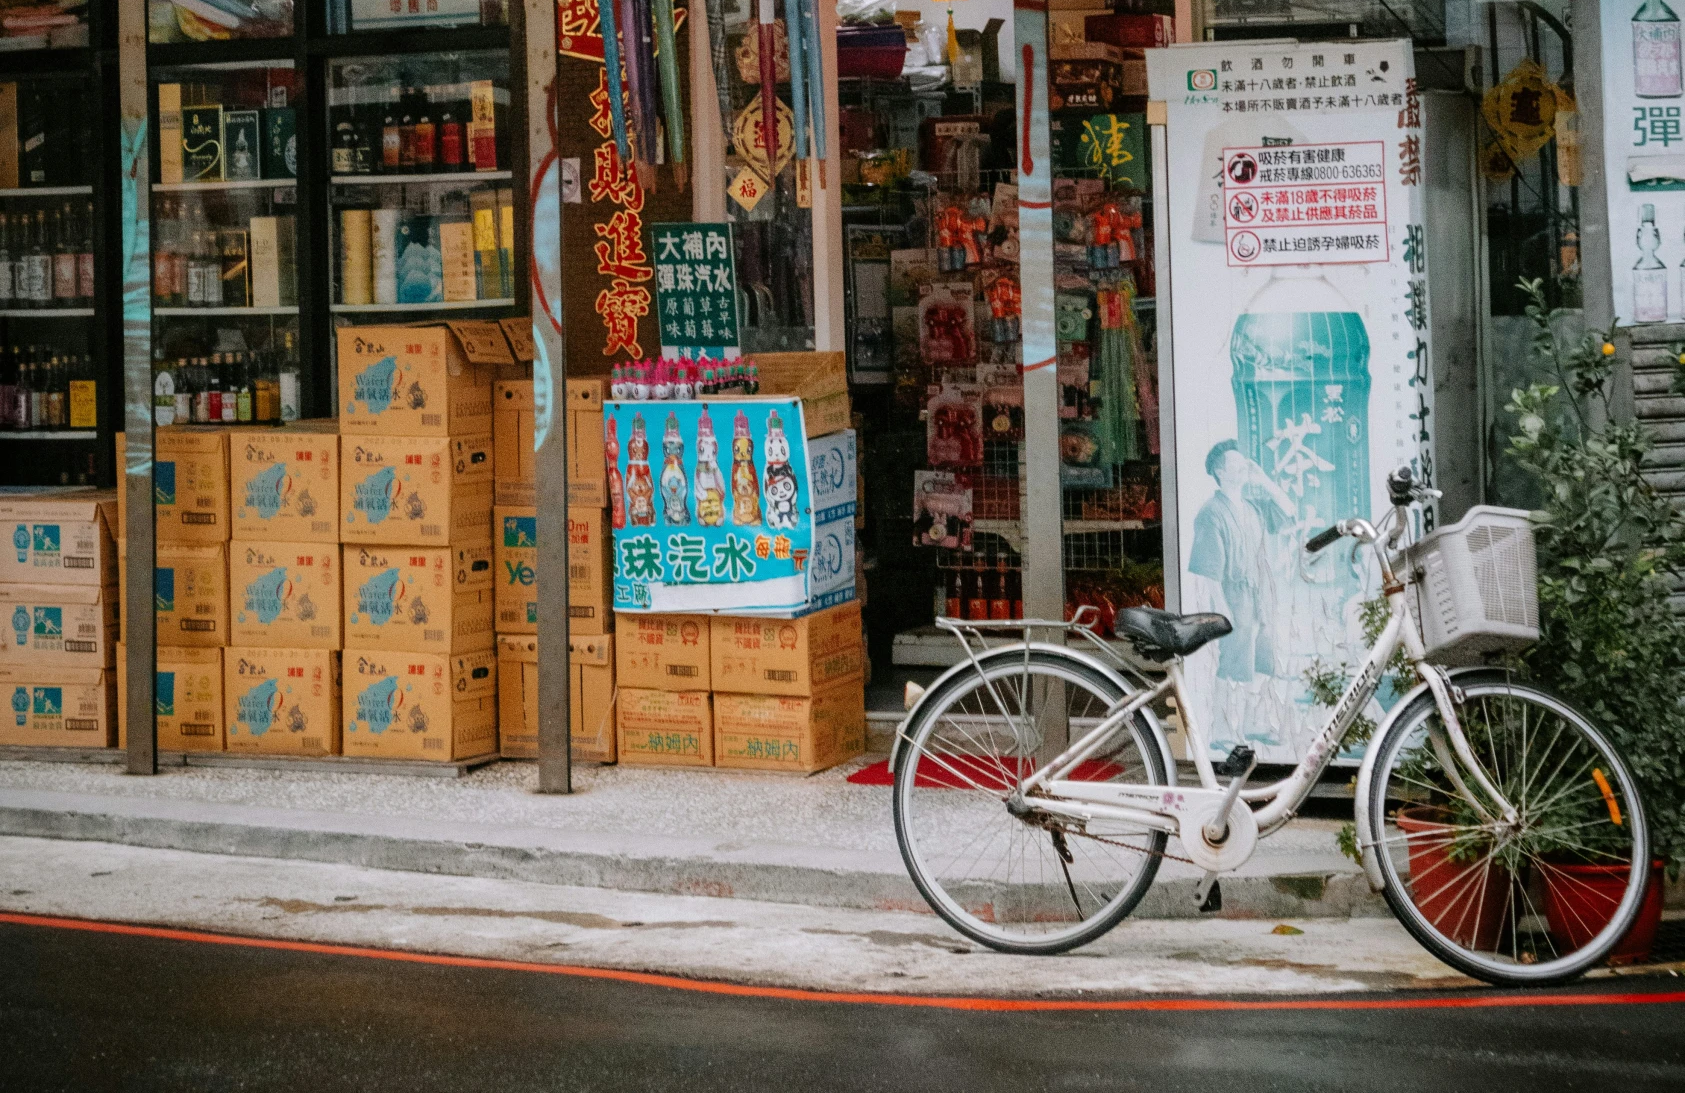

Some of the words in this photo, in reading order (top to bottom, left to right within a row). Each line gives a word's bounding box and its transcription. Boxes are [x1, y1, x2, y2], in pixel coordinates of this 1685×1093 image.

[1221, 53, 1357, 73] 飲酒勿開車
[1221, 93, 1404, 114] 本場所不販賣酒予未滿十八歲者
[1632, 105, 1683, 148] 彈
[1258, 148, 1346, 165] 吸菸有害健康
[1259, 163, 1383, 183] 戒菸專線0800-636363
[739, 177, 758, 199] 福
[1261, 187, 1378, 204] 未滿18歲不得吸菸
[1261, 204, 1379, 223] 及禁止供應其菸品
[659, 231, 728, 261] 大補內
[1262, 235, 1381, 253] 禁止迫誘孕婦吸菸
[657, 263, 733, 293] 彈珠汽水
[1321, 384, 1344, 423] 黑松
[613, 533, 756, 581] 珠汽水
[505, 559, 535, 586] Ye
